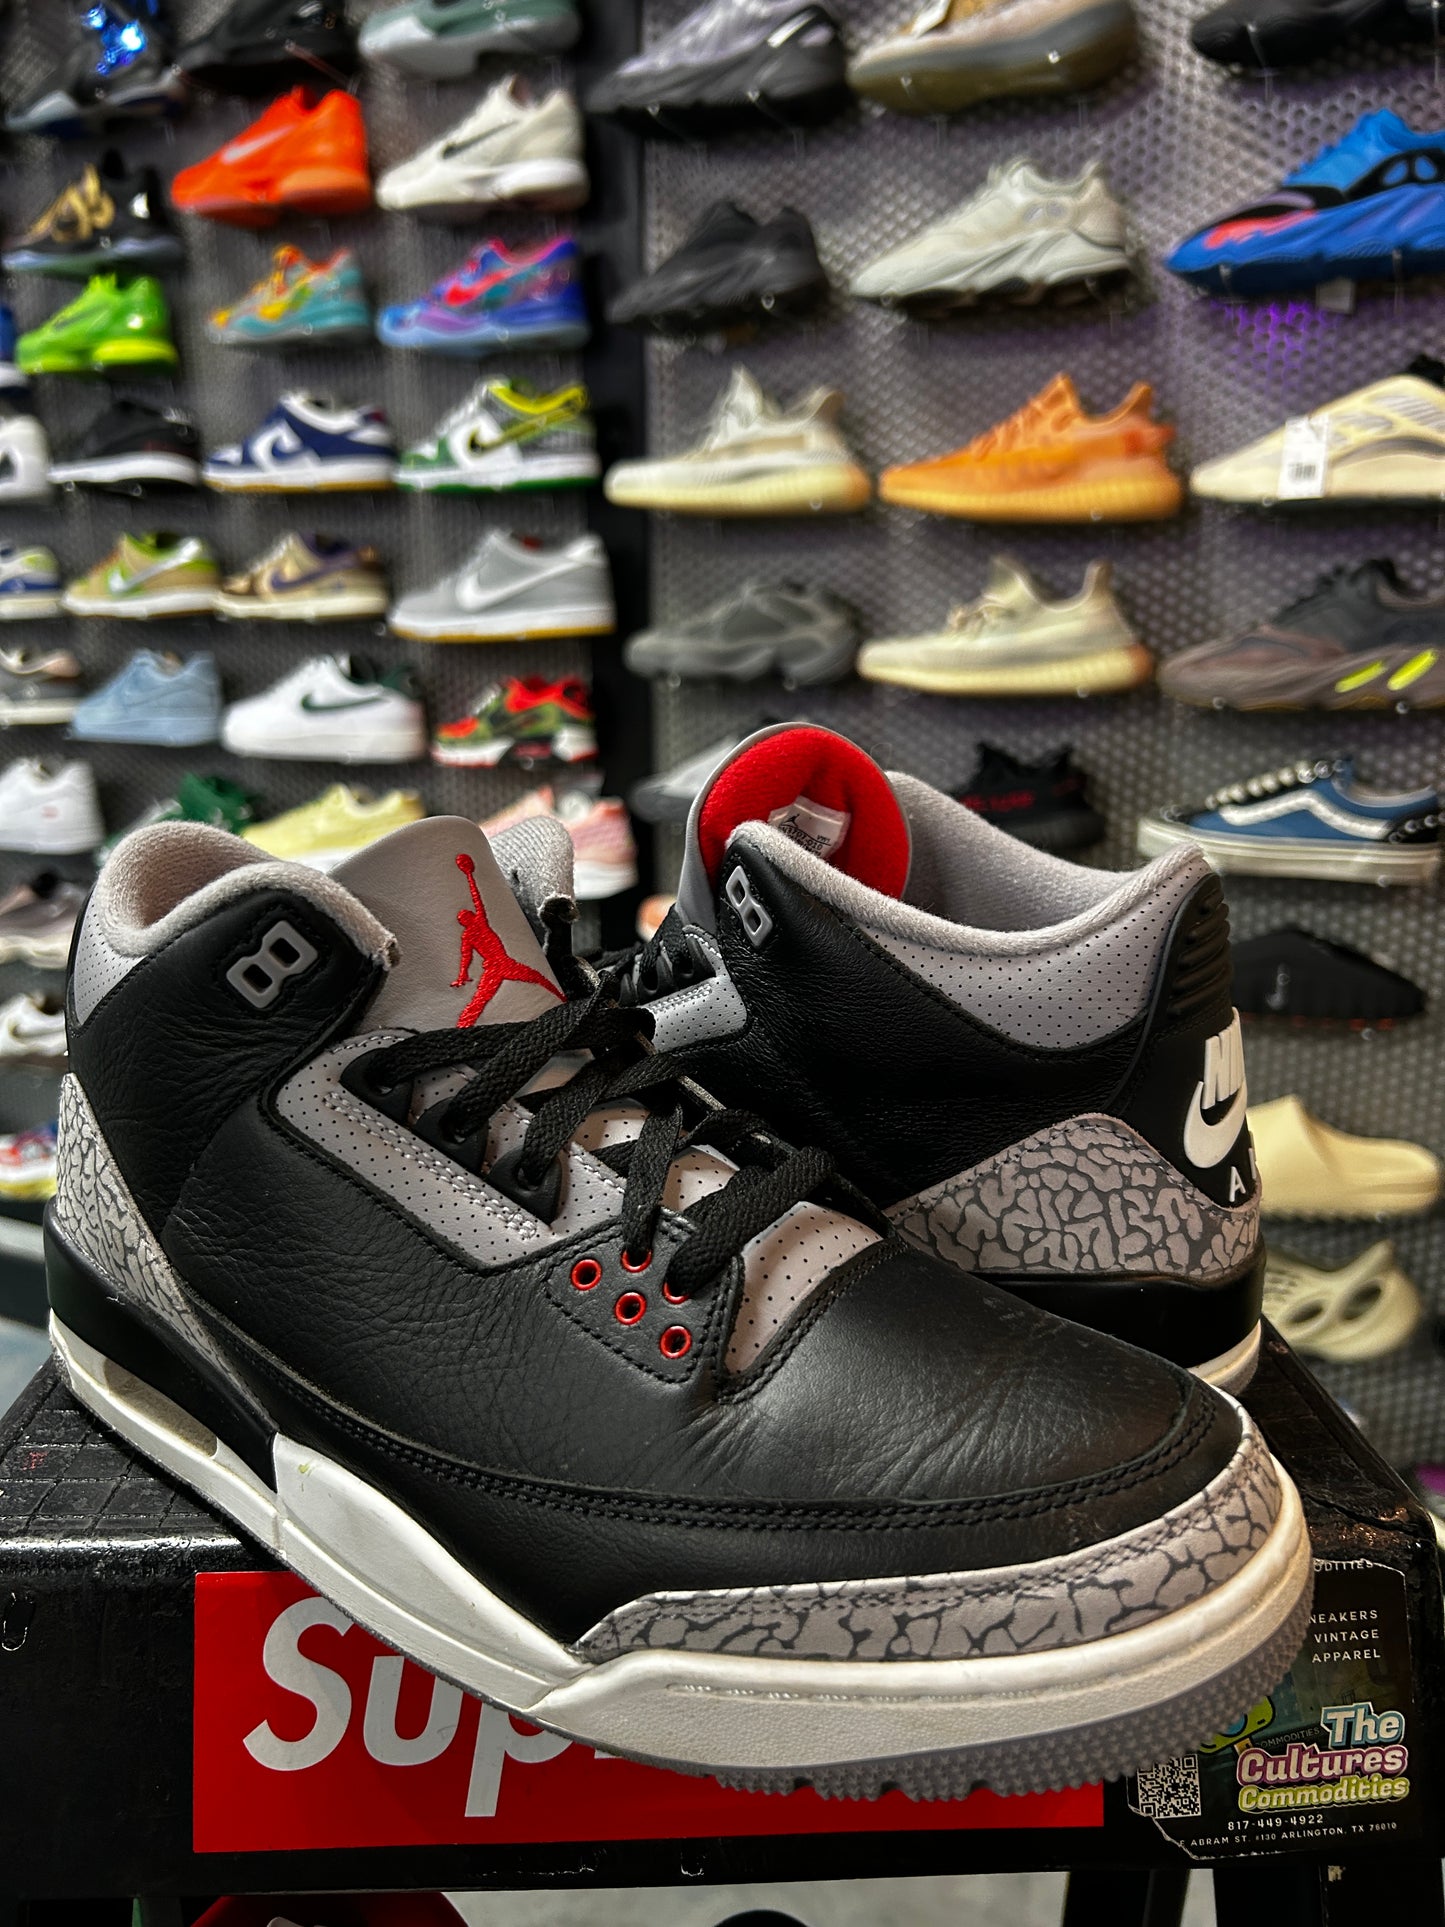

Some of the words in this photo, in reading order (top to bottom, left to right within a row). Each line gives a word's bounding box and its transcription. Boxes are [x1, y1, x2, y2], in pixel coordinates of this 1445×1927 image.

[1313, 1560, 1374, 1572] ODITIES
[1309, 1609, 1378, 1624] NEAKERS
[1314, 1629, 1380, 1644] VINTAGE
[1311, 1648, 1381, 1664] APPAREL
[243, 1596, 622, 1818] Sup
[1324, 1704, 1402, 1746] The
[1239, 1745, 1405, 1784] Cultures
[1241, 1775, 1408, 1810] Commodities
[1227, 1814, 1324, 1831] 817-449-4922
[1190, 1836, 1229, 1847] ABRAM
[1351, 1824, 1365, 1833] TX
[1369, 1822, 1398, 1832] 76010
